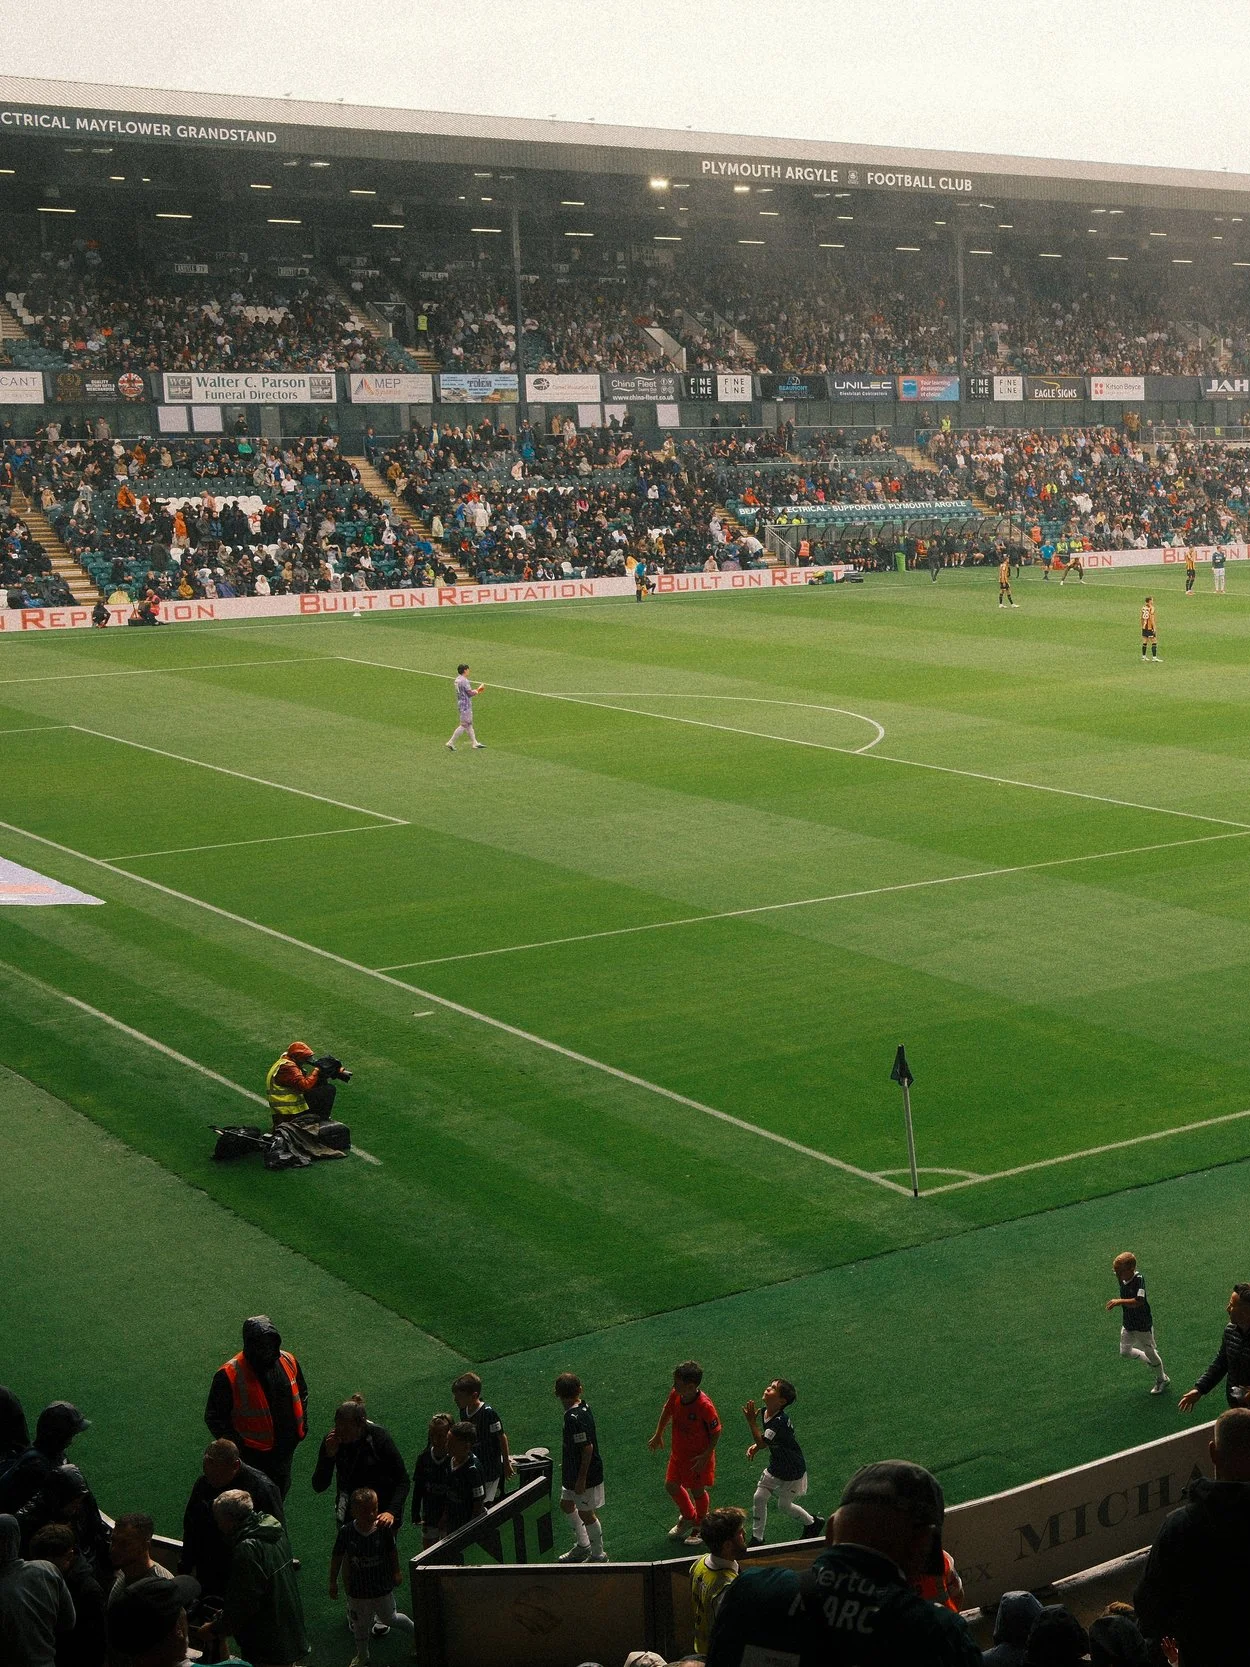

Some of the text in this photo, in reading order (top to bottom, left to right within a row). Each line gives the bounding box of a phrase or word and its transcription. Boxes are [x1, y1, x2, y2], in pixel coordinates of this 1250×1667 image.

[0, 112, 277, 143] CTRICAL MAYFLOWER GRANDSTAND
[702, 160, 838, 183] PLYMOUTH ARGYLE
[867, 172, 972, 191] FOOTBALL CLUB
[0, 377, 37, 386] CANT
[170, 378, 191, 386] WCP
[196, 376, 306, 388] Walter C. Parson
[311, 378, 331, 386] WCP
[374, 378, 401, 388] MEP
[611, 379, 657, 388] China Fleet
[690, 378, 712, 386] FINE
[724, 378, 745, 386] FINE
[1206, 380, 1248, 392] JAH
[205, 390, 298, 400] Funeral Directors
[690, 386, 712, 394] LINE
[724, 386, 745, 394] LINE
[1034, 388, 1077, 398] EAGLE SIGNS
[778, 500, 967, 513] ECTRICAL SUPPORTING PLYMOUTH ARGYLE
[1163, 548, 1211, 564] BULT
[658, 575, 721, 593] BUILT
[732, 574, 761, 587] ON
[300, 583, 594, 614] BUILT ON REPUTATION
[21, 604, 215, 629] REPTION
